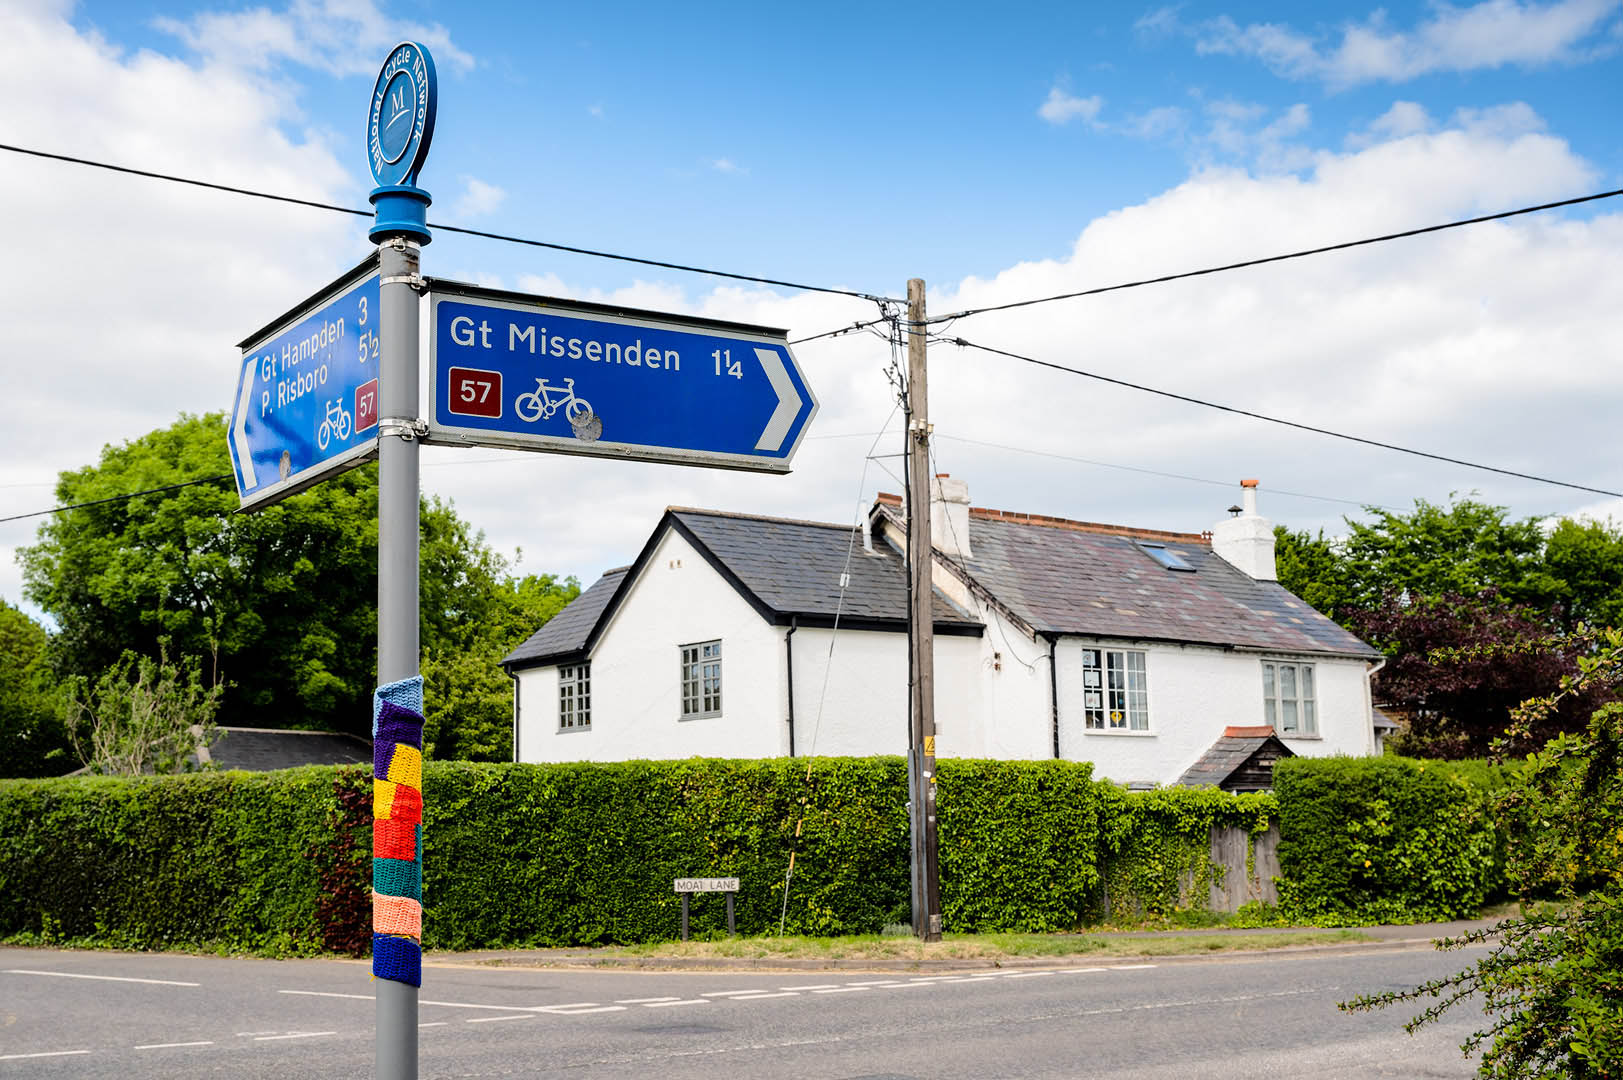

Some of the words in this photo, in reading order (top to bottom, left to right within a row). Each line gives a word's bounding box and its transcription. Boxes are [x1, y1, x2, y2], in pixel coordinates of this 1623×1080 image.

[370, 91, 384, 176] National
[384, 47, 411, 80] Cycle
[412, 56, 427, 143] Network
[391, 86, 405, 117] M
[262, 354, 277, 382] Gt
[281, 317, 345, 372] Hampden
[358, 296, 368, 326] 3
[450, 316, 493, 349] Gt
[508, 322, 680, 372] Missenden
[262, 390, 273, 418] P.
[360, 392, 374, 418] 57
[460, 380, 492, 404] 57
[677, 880, 703, 890] MOAT
[710, 880, 736, 890] LANE
